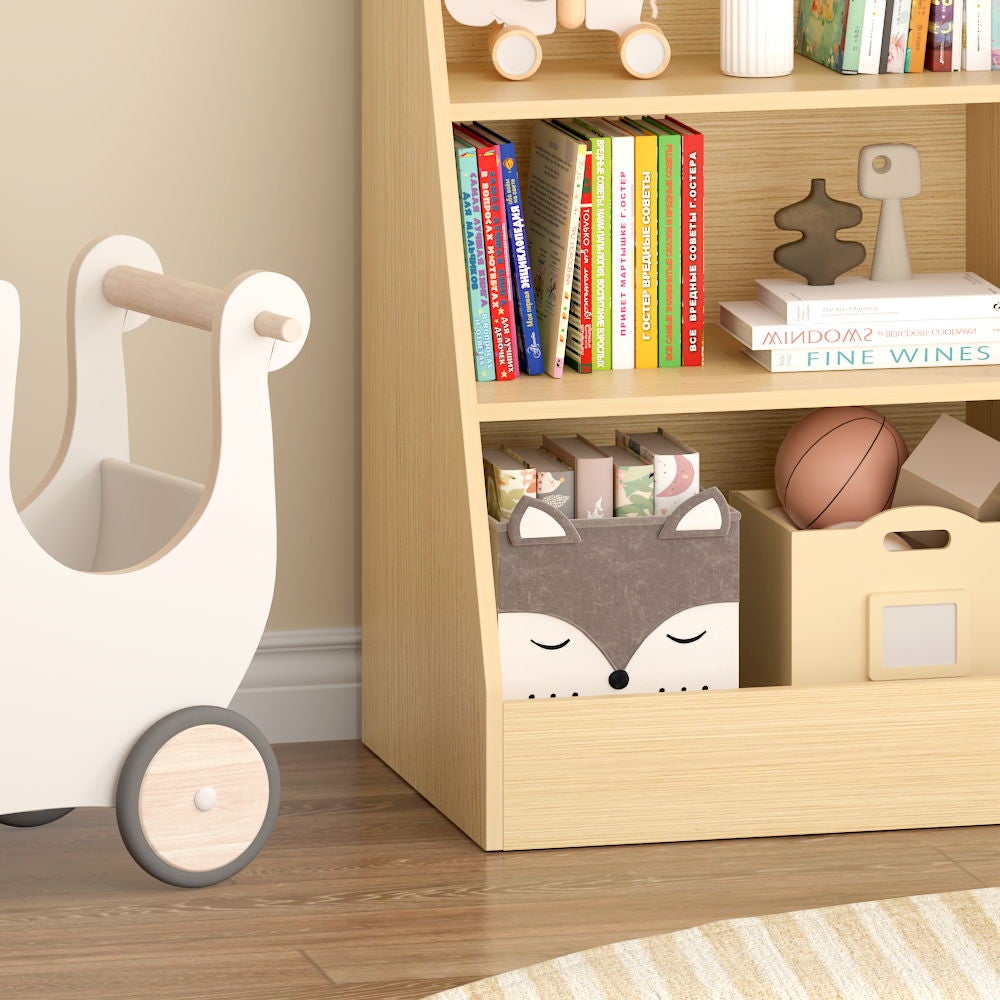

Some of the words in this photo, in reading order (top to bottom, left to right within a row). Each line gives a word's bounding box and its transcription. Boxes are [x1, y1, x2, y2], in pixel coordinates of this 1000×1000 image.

[595, 139, 605, 175] ВРЕДНЫЕ
[665, 144, 673, 178] СОВЕТЫ
[642, 171, 651, 224] СОВЕТЫ
[665, 179, 674, 218] ВРЕДНЫЕ
[689, 151, 697, 209] Г.ОСТЕРА
[482, 182, 494, 242] ВОПРОСАХ
[489, 258, 500, 309] ОТВЕТАХ
[510, 205, 531, 289] ЭНЦИКЛОПЕДИЯ
[582, 208, 590, 247] ТОЛЬКО
[665, 226, 673, 256] СКАЗКИ
[689, 212, 697, 261] СОВЕТЫ
[466, 221, 478, 291] МАЛЬЧИКОВ
[580, 248, 590, 264] для
[642, 227, 652, 288] ВРЕДНЫЕ
[523, 291, 533, 313] первая
[596, 279, 605, 327] ВОСПИТАНИЕ
[665, 258, 673, 313] ЗНАМЕНИТЫЕ
[689, 265, 698, 322] ВРЕДНЫЕ
[501, 316, 510, 334] ДЛЯ
[525, 314, 534, 327] Моя
[642, 289, 651, 330] ОСТЕР
[665, 314, 673, 344] САМЫЕ
[494, 326, 506, 366] ДЕВОЧЕК
[504, 337, 514, 373] ЛУЧШИХ
[596, 327, 605, 368] ВЗРОСЛЫХ
[665, 345, 673, 361] ВСЕ
[689, 328, 697, 352] ВСЕ
[807, 350, 874, 367] FINE
[890, 345, 992, 364] WINES
